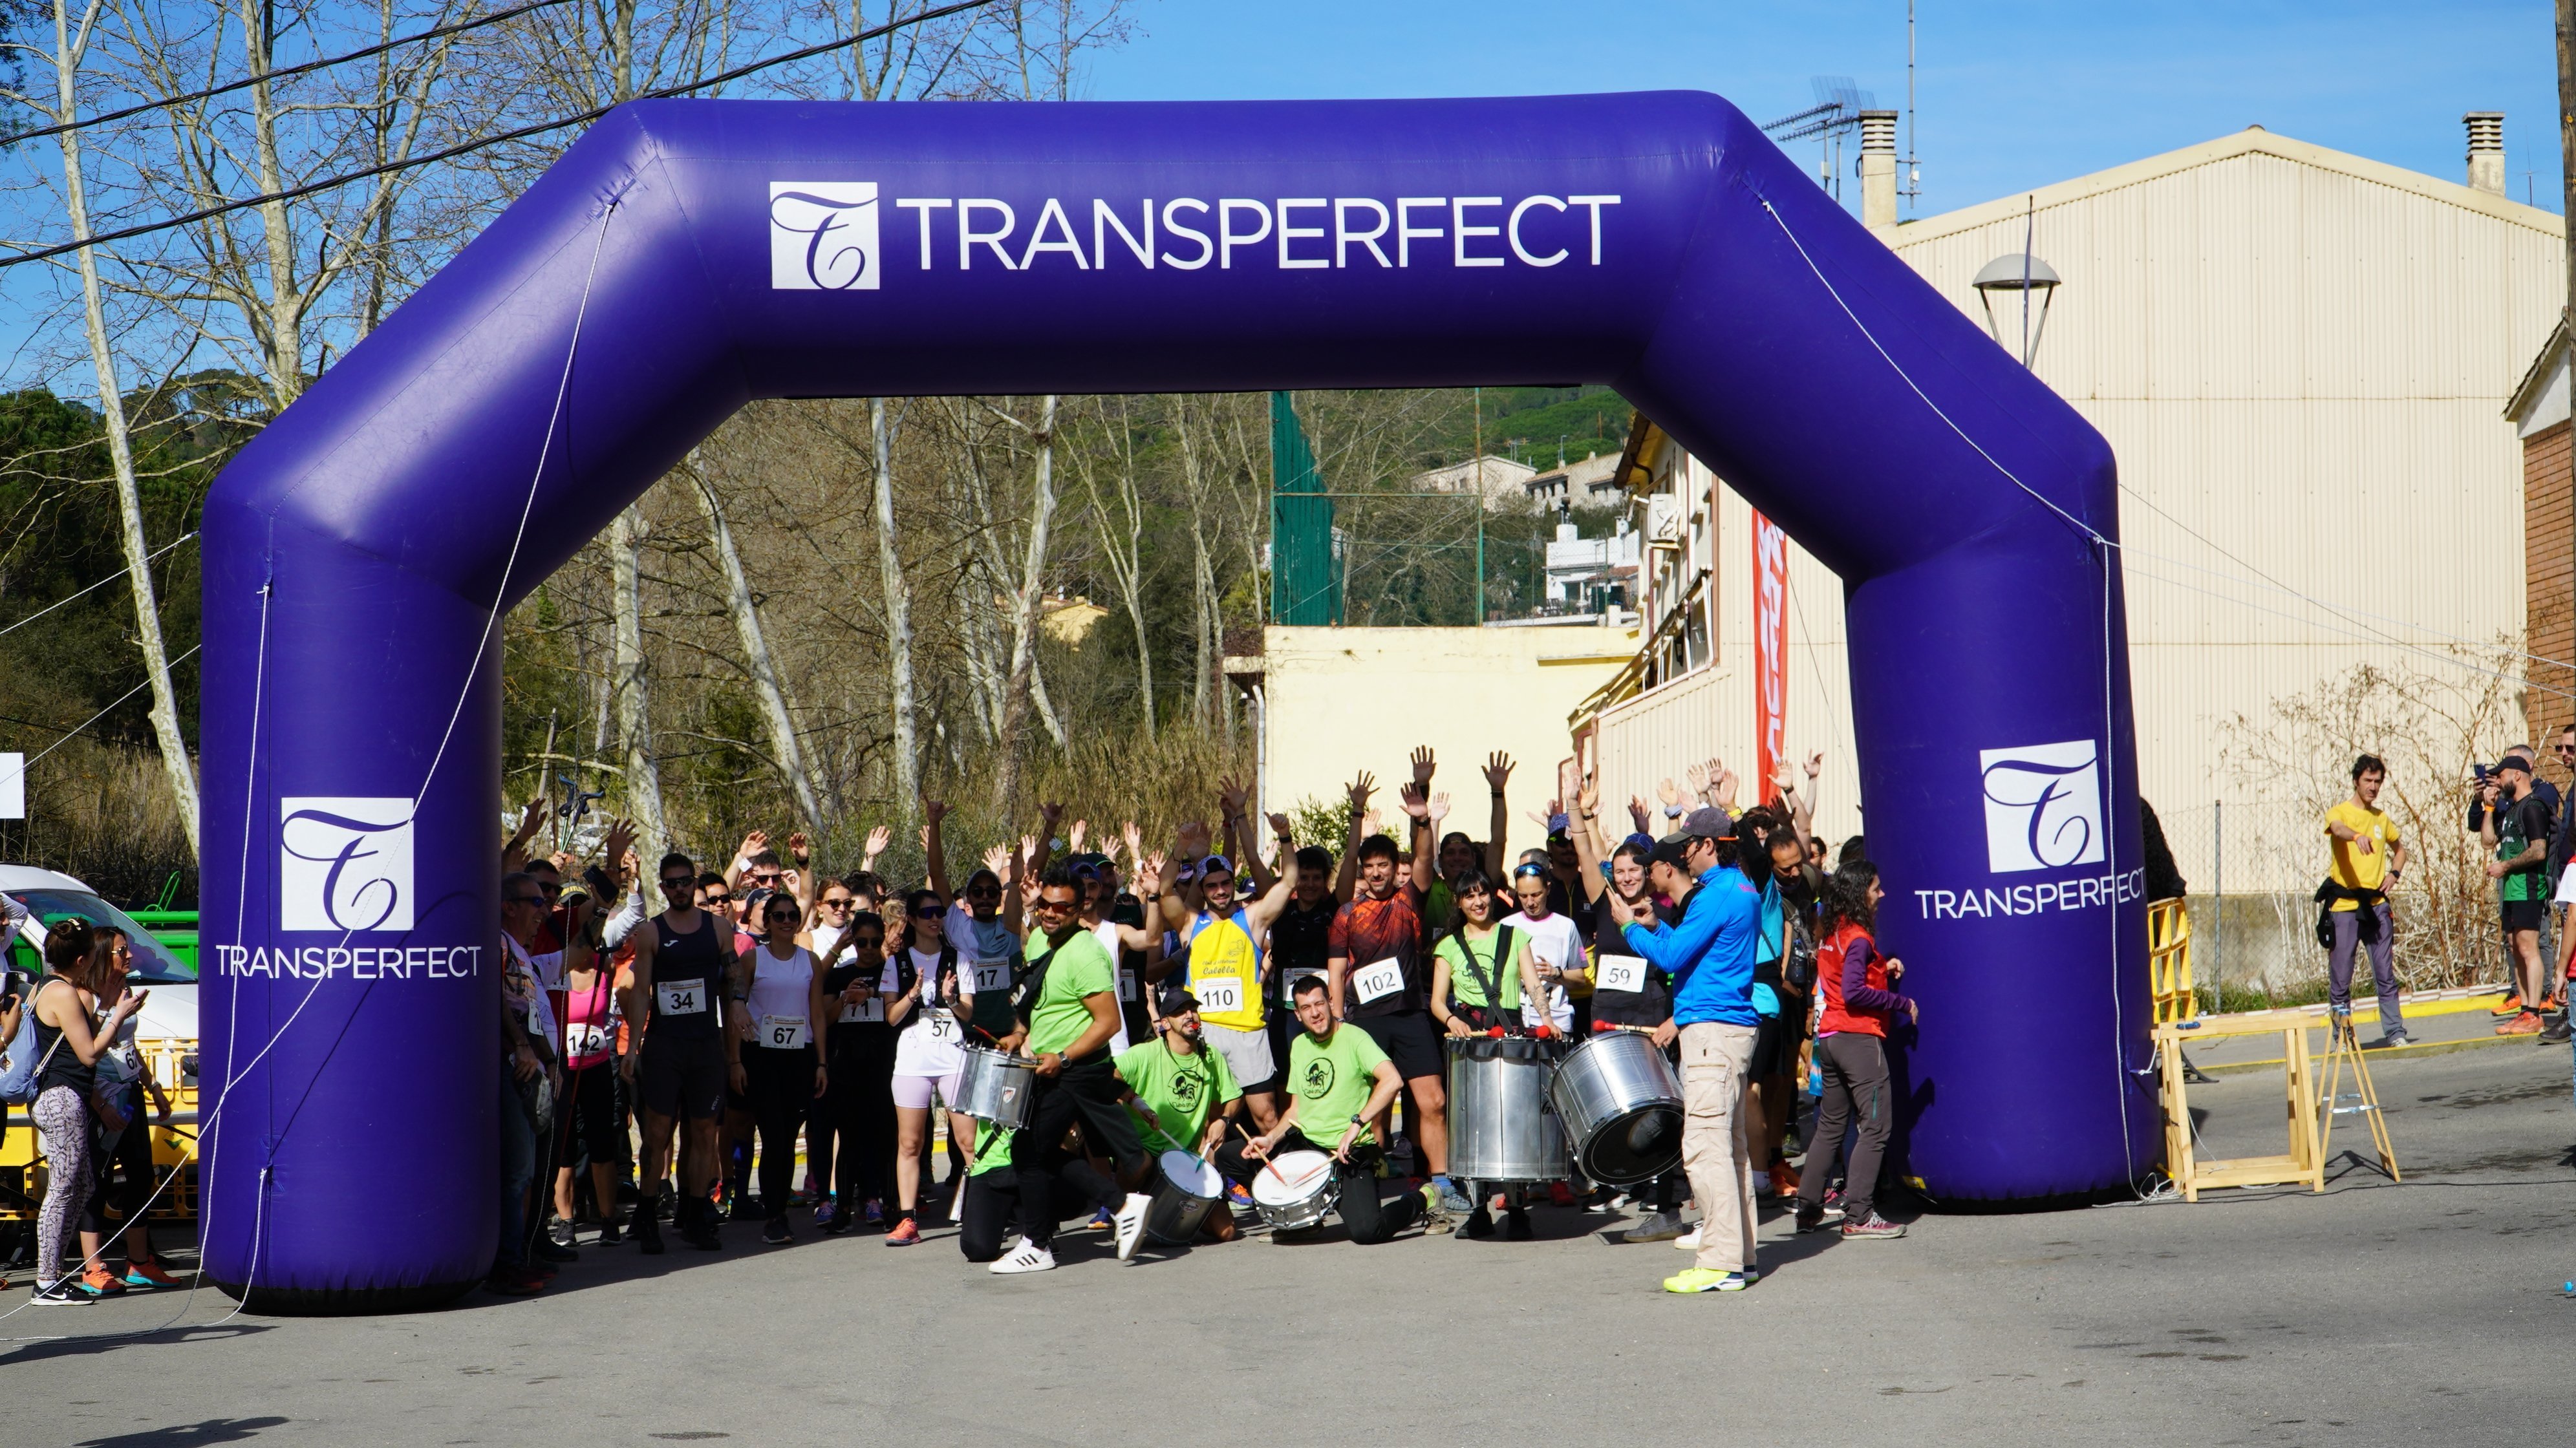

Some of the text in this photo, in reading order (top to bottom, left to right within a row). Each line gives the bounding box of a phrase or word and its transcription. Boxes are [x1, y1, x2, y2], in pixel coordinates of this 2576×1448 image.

[896, 195, 1622, 270] TRANSPERFECT
[1914, 866, 2145, 920] TRANSPERFECT
[215, 944, 482, 979] TRANSPERFECT
[977, 969, 998, 986] 17
[1363, 972, 1396, 994] 102
[1608, 968, 1631, 985] 59
[671, 992, 694, 1010] 34
[1203, 989, 1234, 1006] 110
[773, 1027, 796, 1044] 67
[932, 1021, 952, 1037] 57
[568, 1034, 600, 1051] 142
